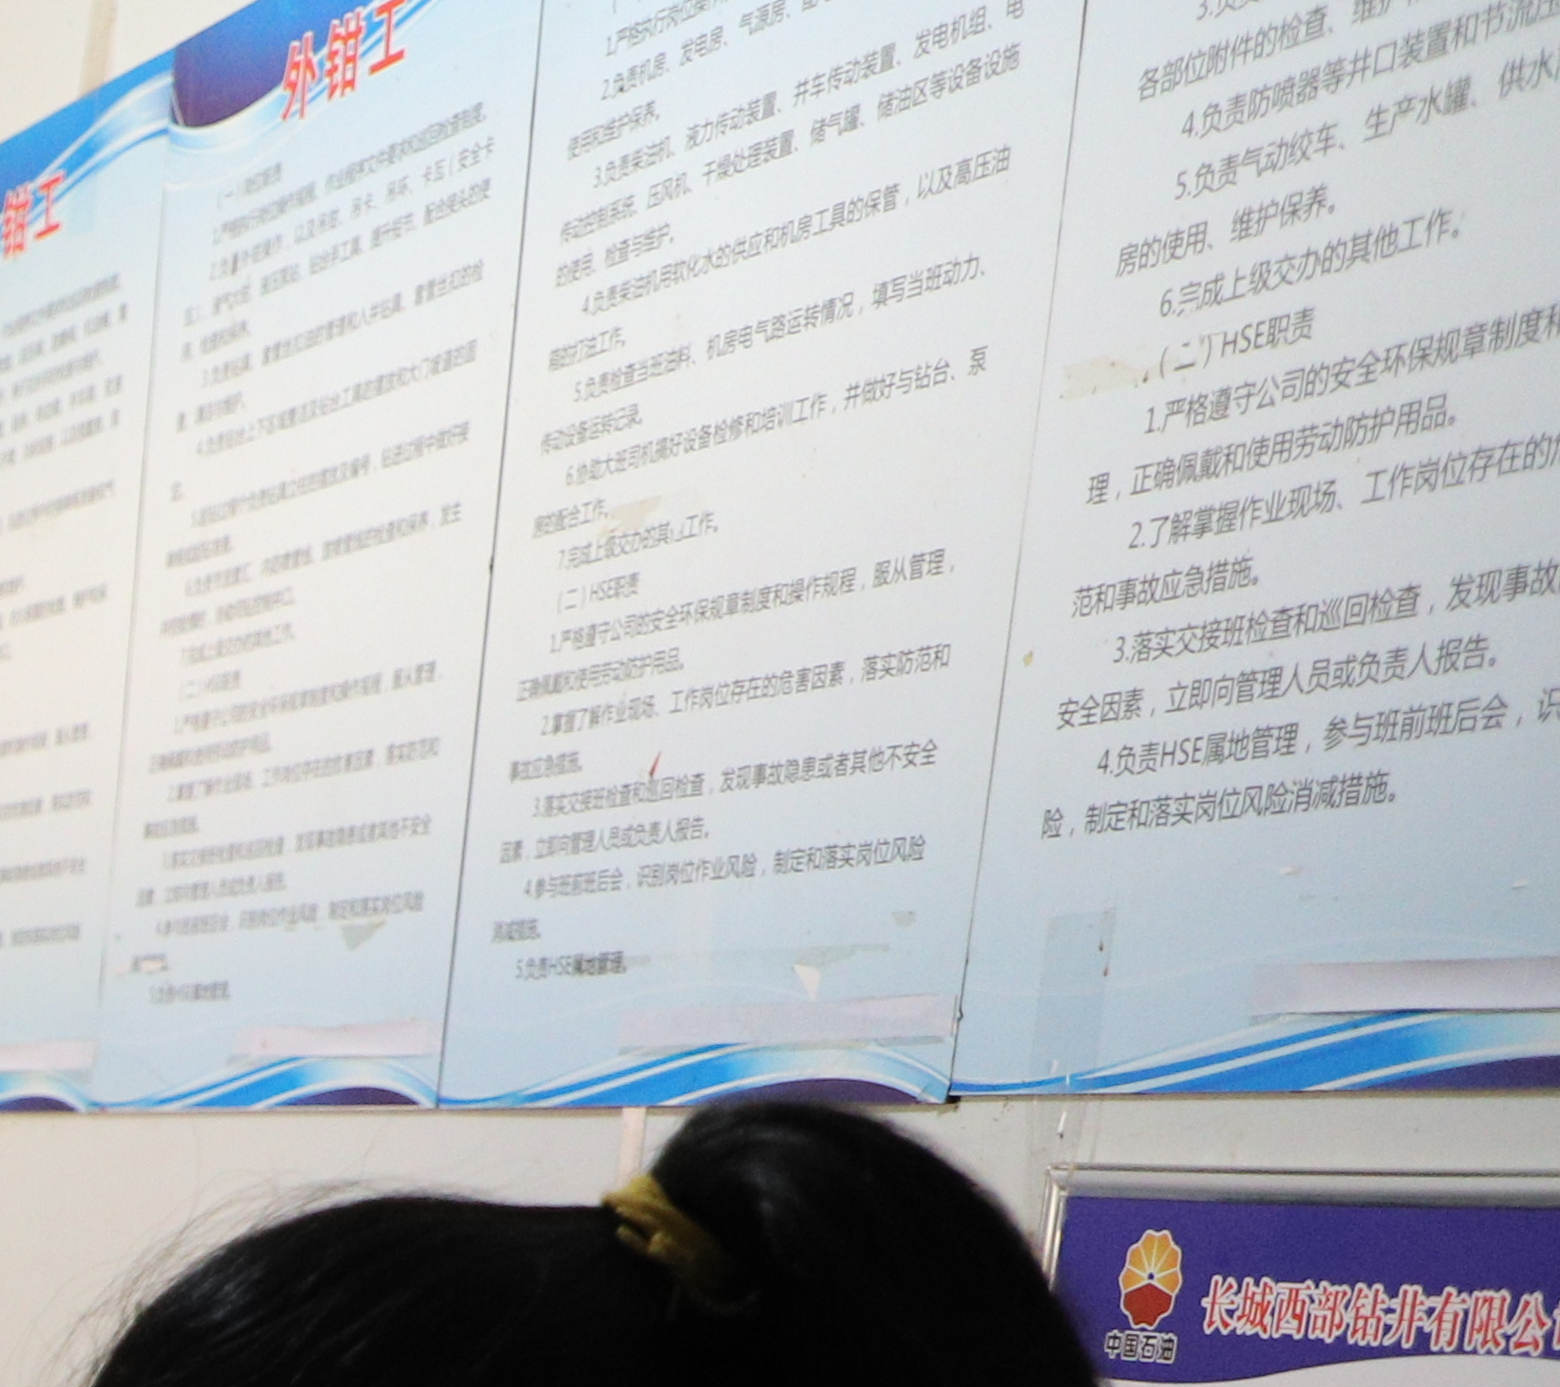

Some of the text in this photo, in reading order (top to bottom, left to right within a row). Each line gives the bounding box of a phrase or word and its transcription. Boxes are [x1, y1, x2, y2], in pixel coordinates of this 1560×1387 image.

[282, 0, 406, 121] 外钳工
[600, 0, 820, 100] 2.负责机房、发电房、气源房、
[1173, 46, 1560, 201] 5.负责气动绞车、生产水罐、供水
[1115, 183, 1337, 278] 房的使用、维护保养。
[1159, 207, 1462, 318] 6.完成上级交办的其他工作。
[1086, 393, 1457, 506] 理，正确佩戴和使用劳动防护用品。
[1070, 554, 1260, 619] 范和事故应急措施。
[1113, 558, 1560, 665] 3.落实交接班检查和巡回检查，发现事故
[1056, 633, 1497, 732] 安全因素，立即向管理人员或负责人报告。
[1041, 769, 1398, 841] 险，制定和落实岗位风险消减措施。
[1104, 1331, 1178, 1364] 中国石油
[1201, 1273, 1560, 1359] 长城西部钻井有限公
